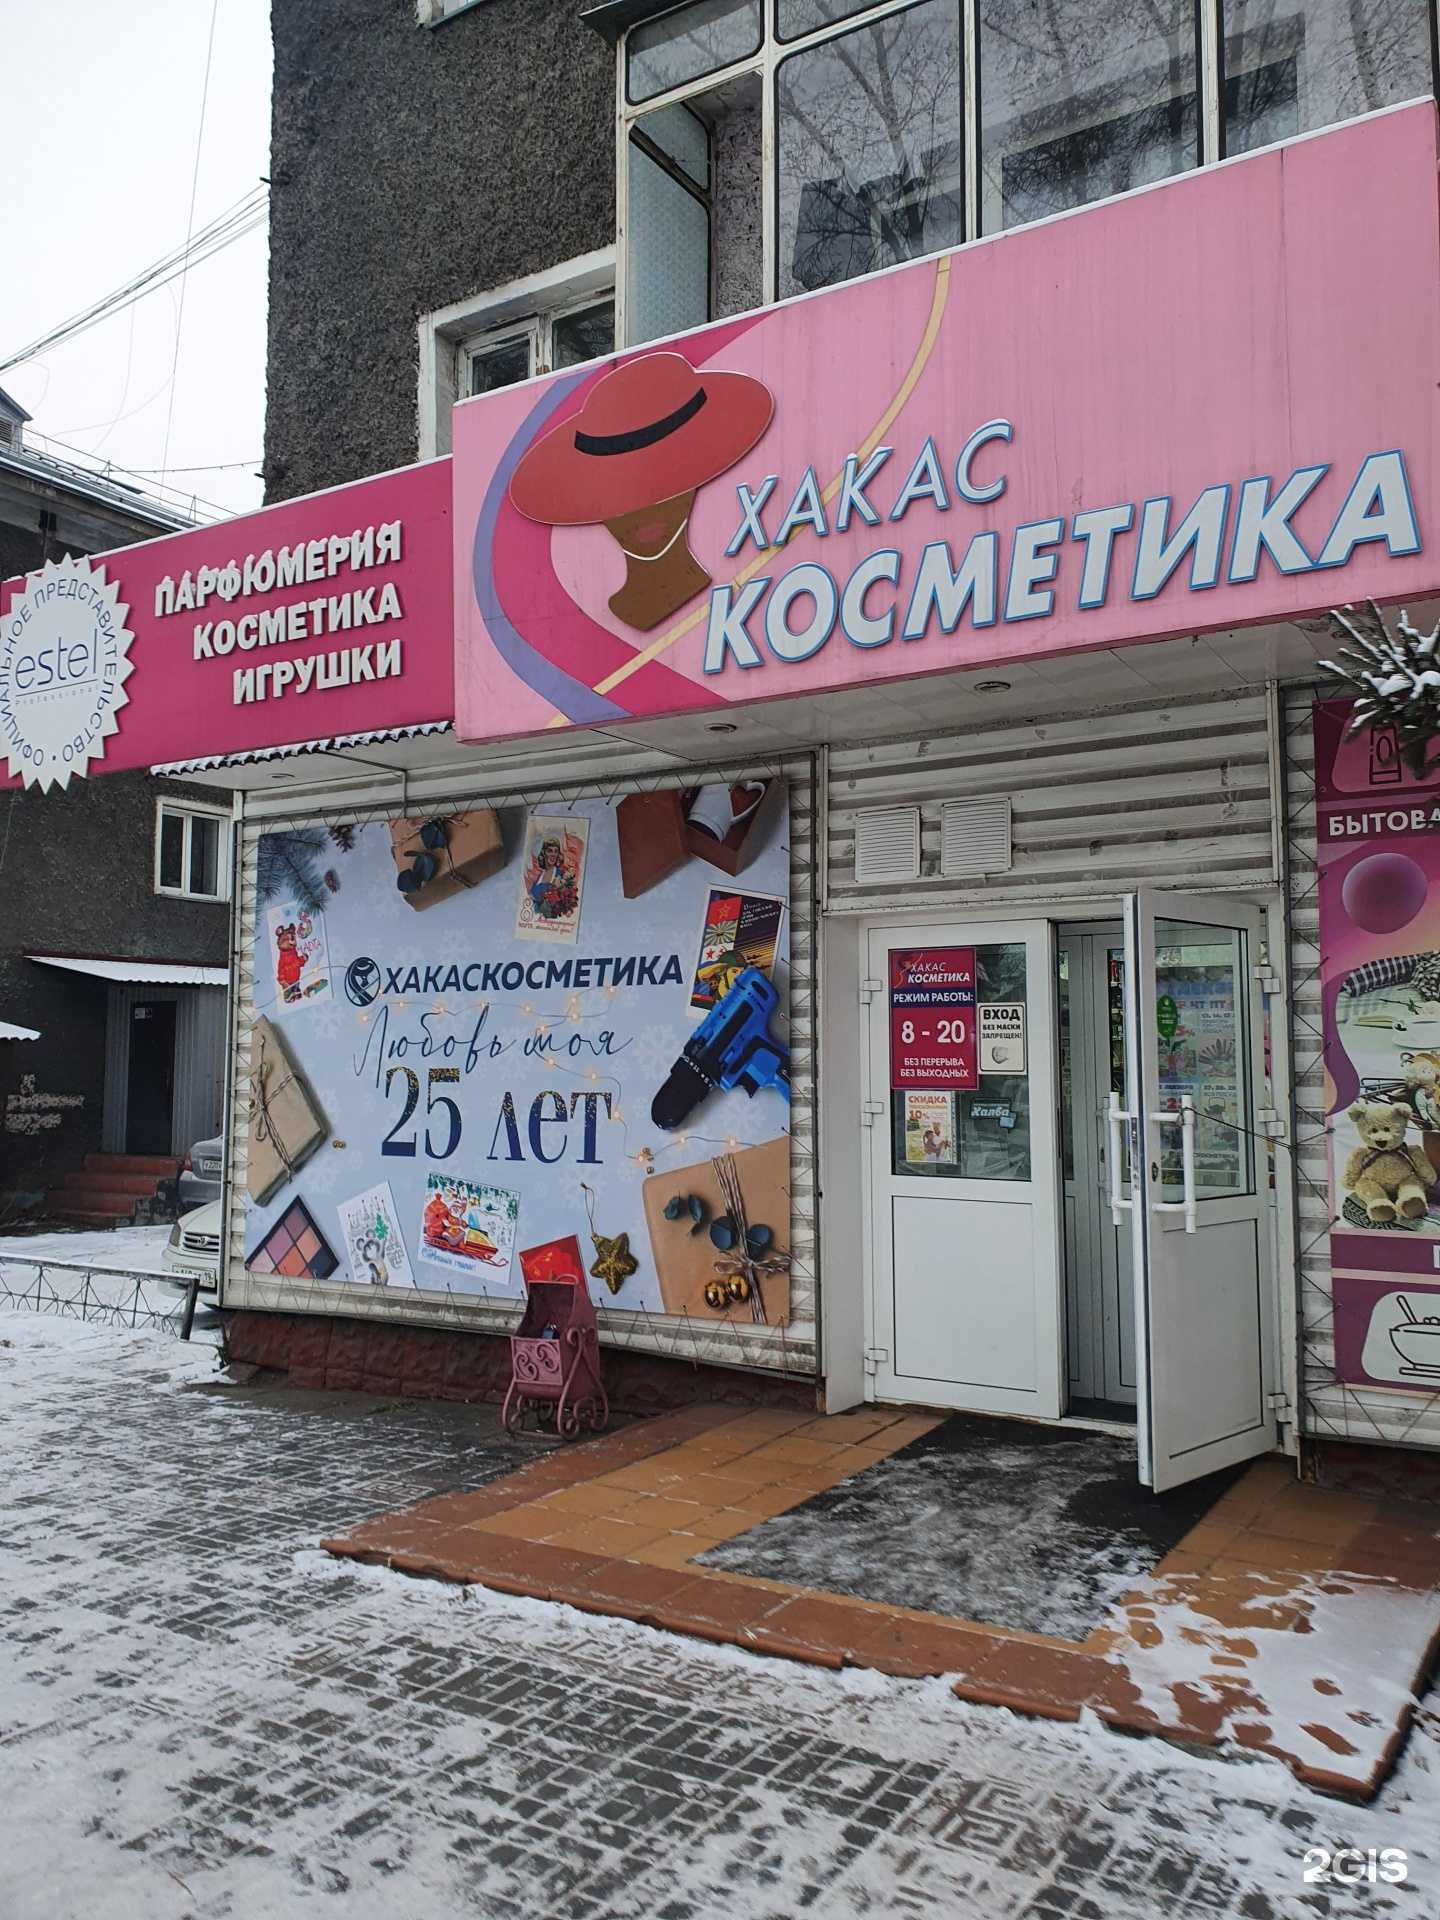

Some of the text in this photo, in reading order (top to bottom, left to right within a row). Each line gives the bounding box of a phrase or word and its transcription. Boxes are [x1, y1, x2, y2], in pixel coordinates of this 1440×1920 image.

[726, 418, 1013, 557] ХАКАС
[154, 519, 402, 617] ПАРФЮМЕРИЯ
[703, 447, 1423, 675] КОСМЕТИКА
[193, 582, 402, 661] КОСМЕТИКА
[15, 628, 98, 689] estel
[34, 578, 118, 762] ПРЕДСТАВИТЕЛЬСТВО
[233, 638, 402, 705] ИГРУШКИ
[382, 954, 684, 994] ХАКАСКОСМЕТИКА
[907, 972, 970, 984] КОСМЕТИКА
[911, 962, 946, 973] ХАКАС
[893, 991, 974, 1003] РЕЖИМ РАБОТЫ:
[983, 1008, 1021, 1022] ВХОД
[353, 1001, 634, 1088] Любовь моя
[901, 1020, 915, 1044] 8
[937, 1019, 965, 1043] 20
[982, 1023, 1021, 1031] БЕЗ МАСКИ
[900, 1068, 969, 1079] БЕЗ ВЫХОДНЫХ
[904, 1057, 965, 1067] БЕЗ ПЕРЕРЫВА
[381, 1066, 463, 1160] 25
[908, 1095, 947, 1105] СКИДКА
